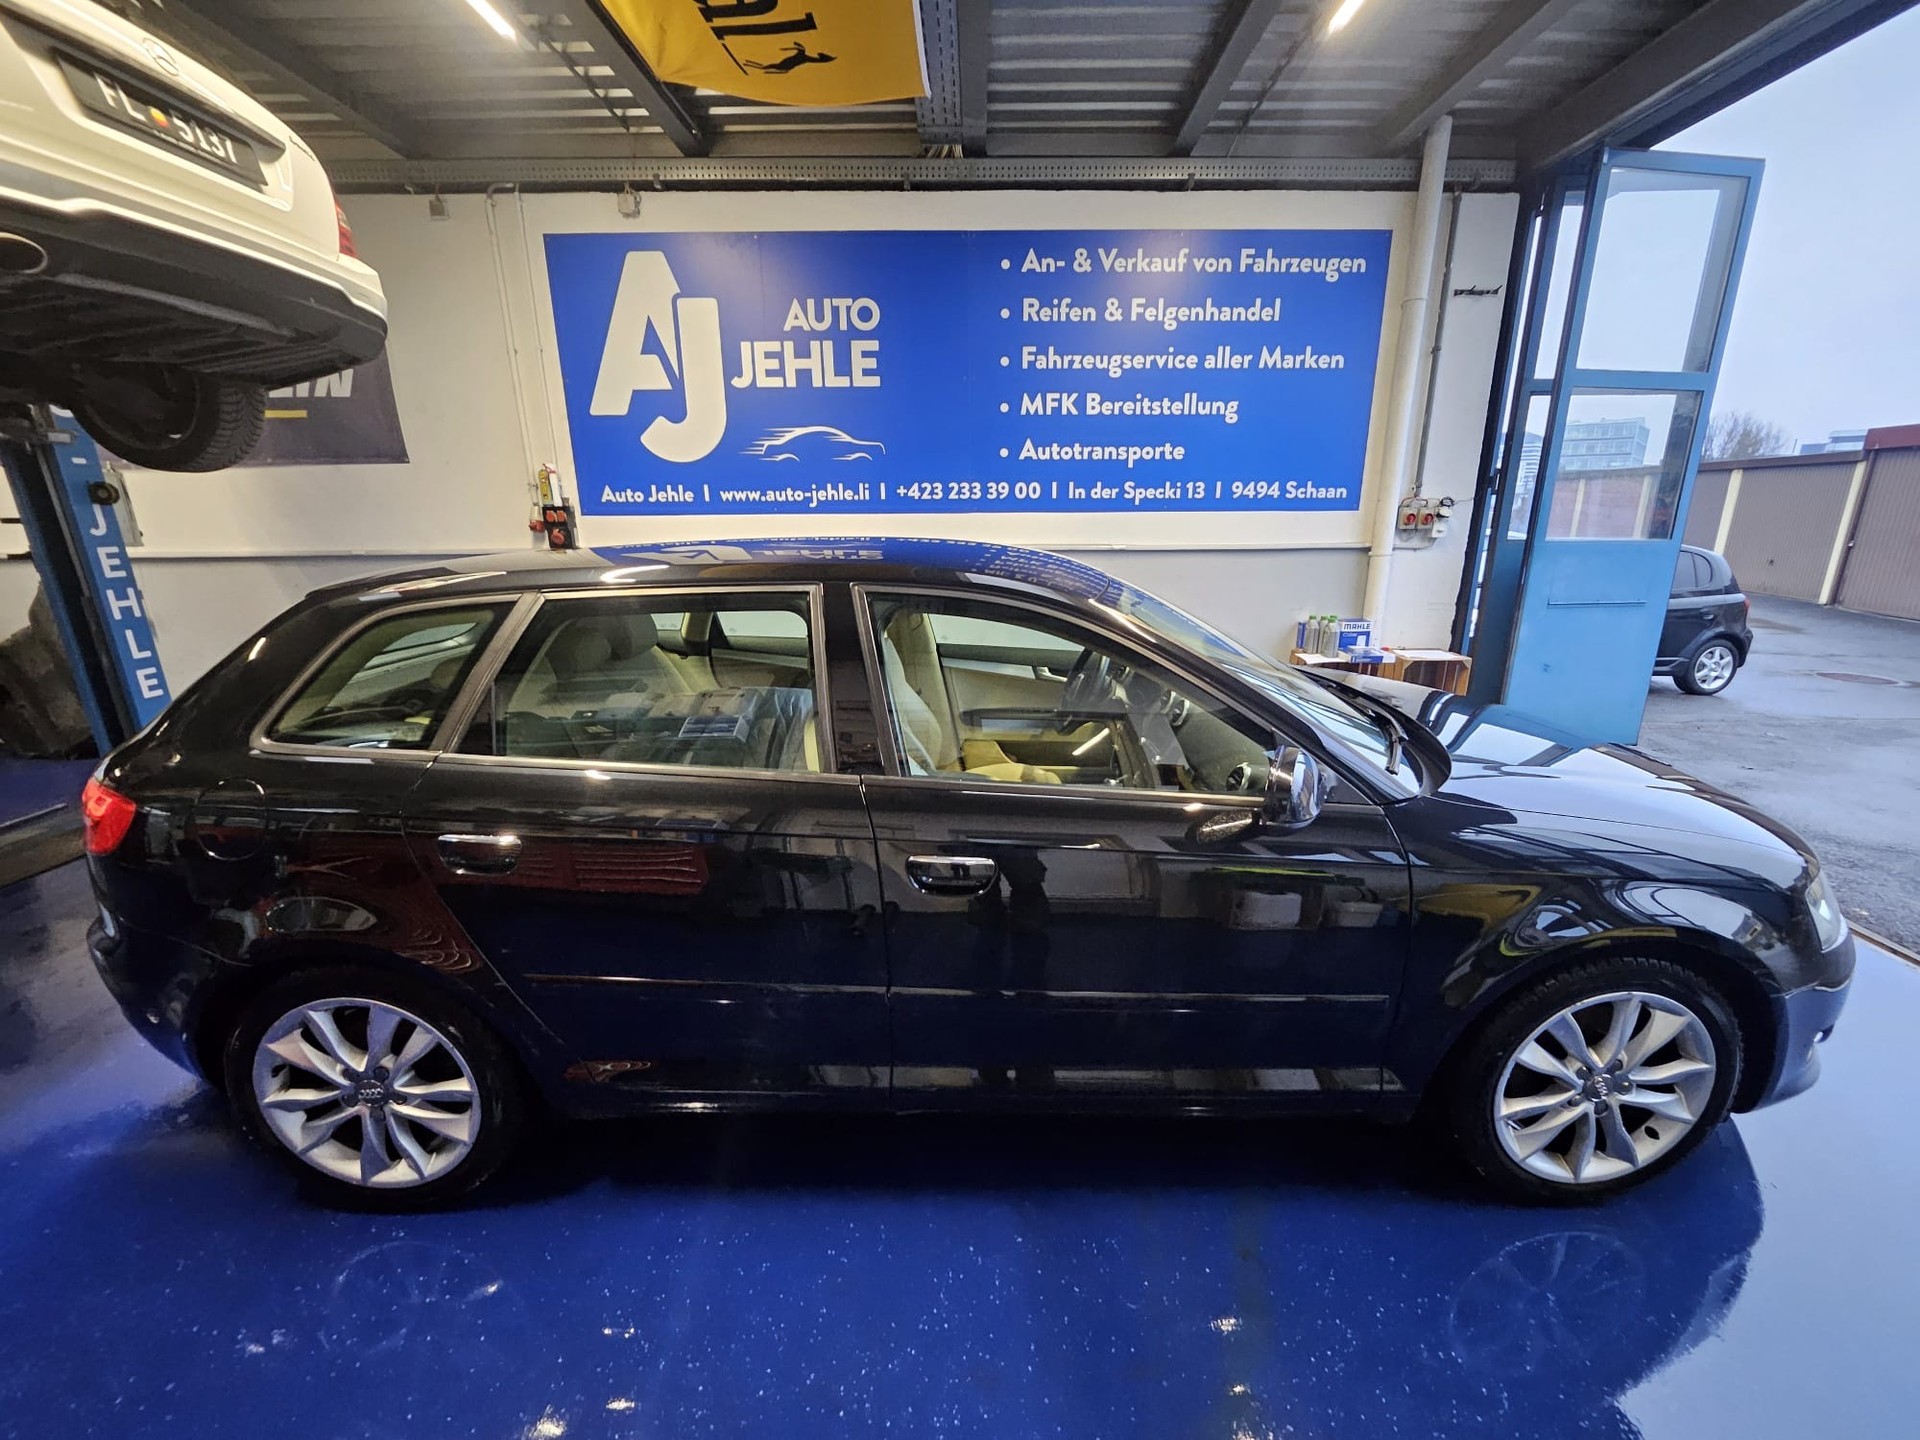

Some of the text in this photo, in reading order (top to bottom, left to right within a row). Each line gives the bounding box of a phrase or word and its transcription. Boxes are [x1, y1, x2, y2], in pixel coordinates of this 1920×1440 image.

[94, 72, 148, 121] FL
[1021, 248, 1367, 282] An- & Verkauf von Fahrzeugen
[784, 298, 880, 331] AUTO
[1022, 298, 1281, 331] Reifen & Felgenhandel
[731, 340, 881, 388] JEHLE
[1022, 346, 1345, 378] Fahrzeugservice aller Marken
[1021, 393, 1239, 423] MFK Bereitstellung
[1019, 438, 1185, 468] Autotransporte
[601, 485, 644, 502] Auto
[648, 485, 694, 503] Jehle
[720, 483, 870, 507] www.auto-jehle.li
[896, 483, 943, 500] +423
[948, 482, 981, 500] 233
[986, 482, 1009, 500] 39
[1015, 482, 1041, 499] 00
[1068, 482, 1085, 499] In
[1090, 482, 1119, 499] der
[1123, 482, 1181, 505] Specki
[1186, 482, 1205, 499] 13
[1231, 482, 1280, 499] 9494
[1285, 481, 1347, 499] Schaan
[89, 504, 164, 699] JEHLE
